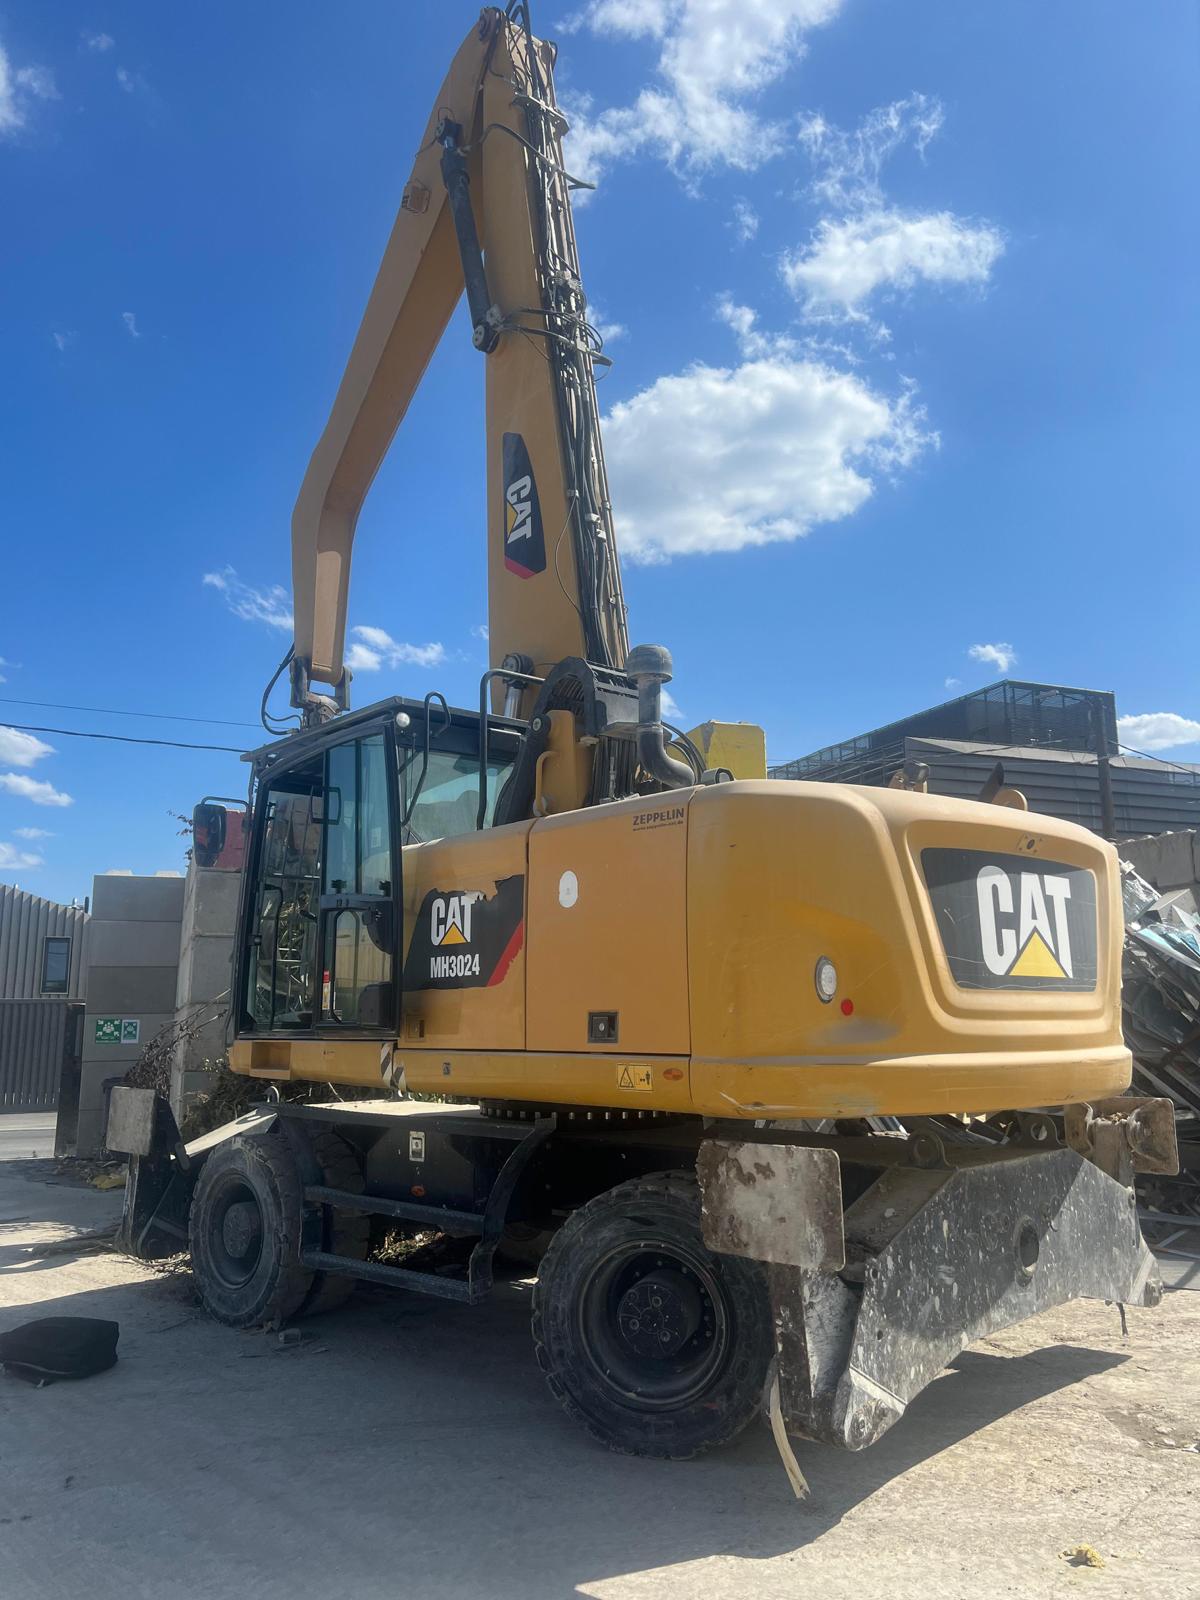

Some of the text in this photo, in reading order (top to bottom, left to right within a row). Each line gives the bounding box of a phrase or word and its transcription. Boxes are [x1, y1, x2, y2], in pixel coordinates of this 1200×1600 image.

[506, 474, 532, 544] CAT
[632, 807, 685, 826] ZEPPELIN
[431, 895, 476, 946] CAT
[976, 865, 1073, 979] CAT
[430, 953, 480, 978] MH3024
